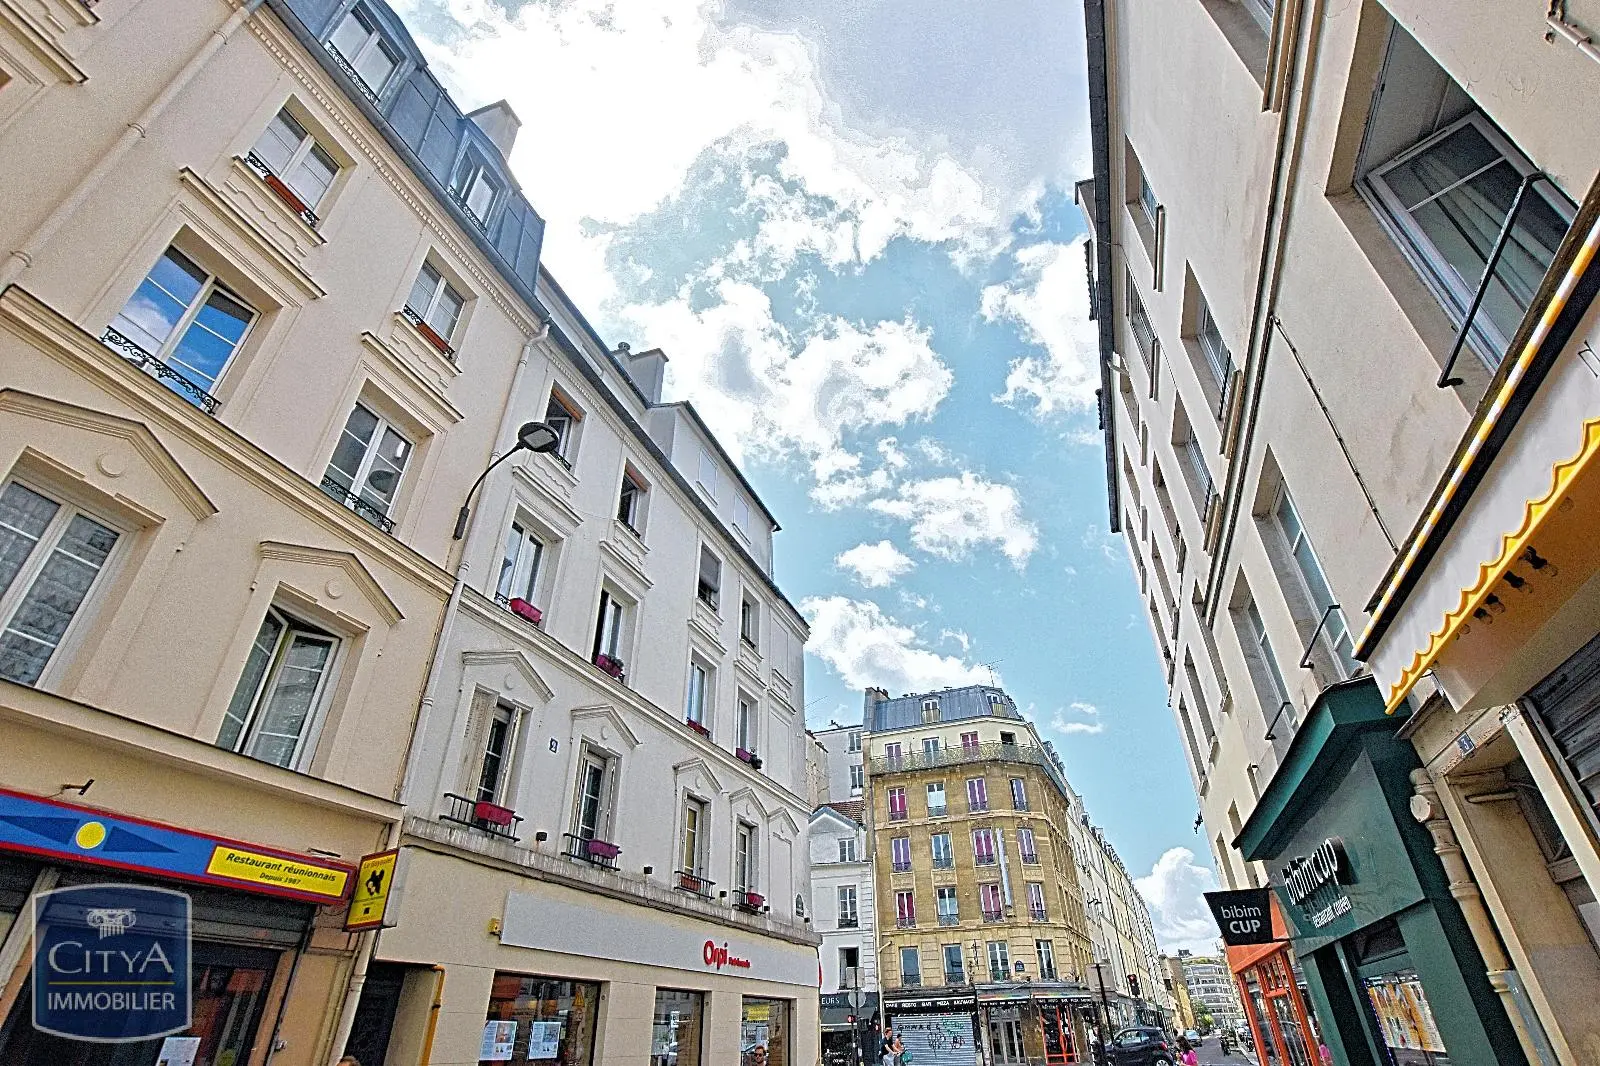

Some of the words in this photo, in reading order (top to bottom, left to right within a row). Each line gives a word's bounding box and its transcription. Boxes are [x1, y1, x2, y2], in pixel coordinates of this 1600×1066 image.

[226, 852, 282, 871] Restaurant
[283, 864, 337, 882] réunionnais
[260, 872, 282, 883] Depuis
[1220, 904, 1262, 919] bibim
[1229, 919, 1261, 934] CUP
[703, 940, 728, 970] Orpi
